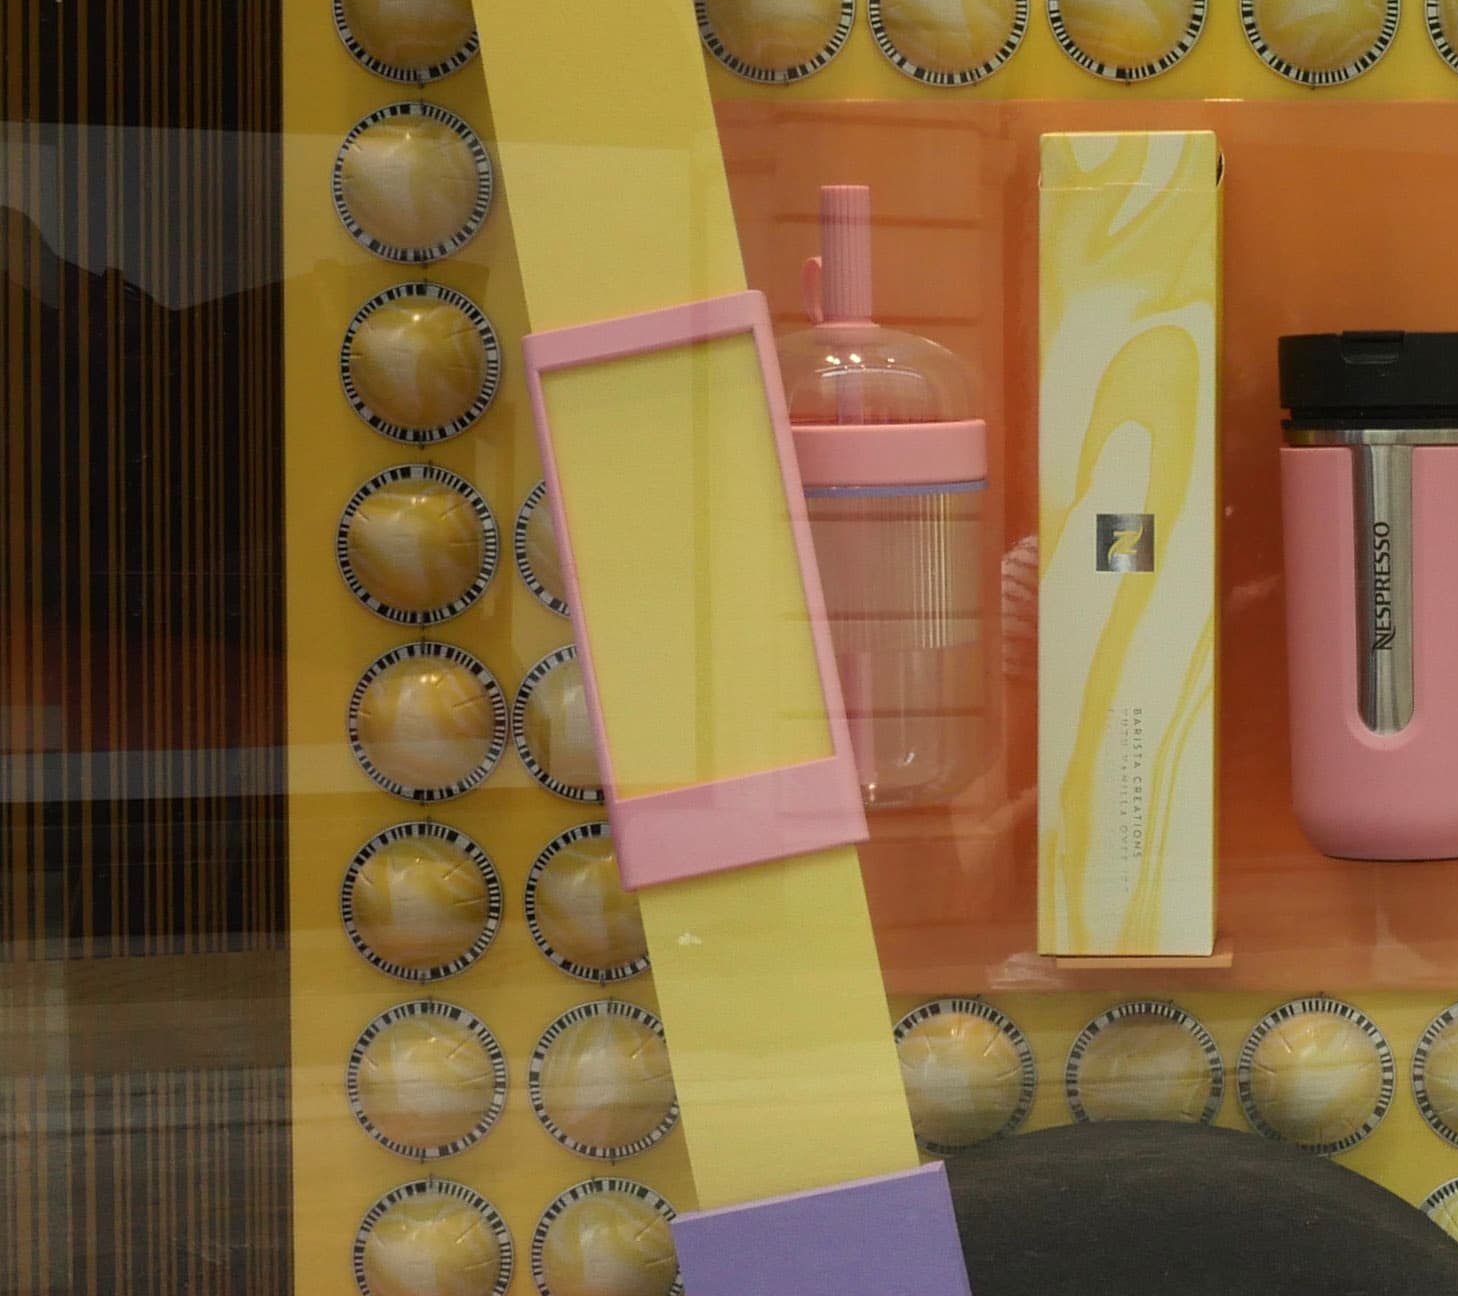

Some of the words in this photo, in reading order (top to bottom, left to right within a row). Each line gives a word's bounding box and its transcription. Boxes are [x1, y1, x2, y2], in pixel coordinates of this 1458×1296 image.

[1372, 522, 1396, 653] NESPRESSO
[1132, 707, 1142, 768] BARISTA
[1132, 775, 1142, 858] CREATIONS
